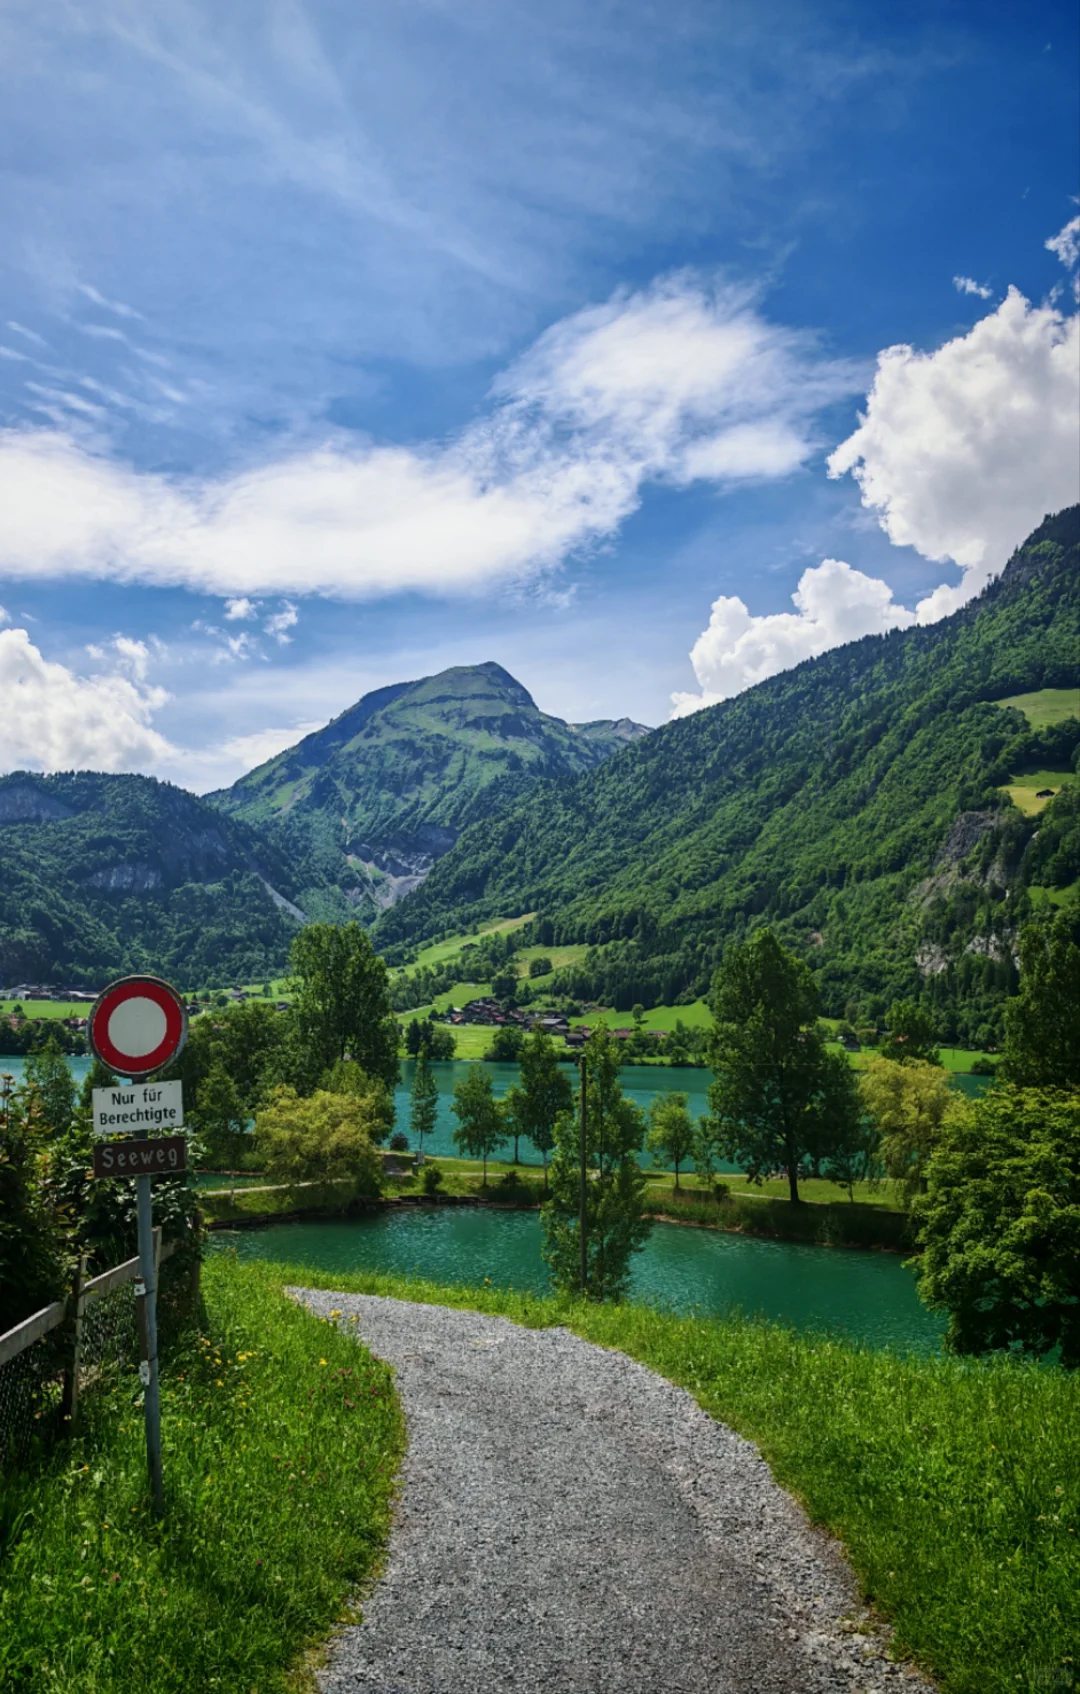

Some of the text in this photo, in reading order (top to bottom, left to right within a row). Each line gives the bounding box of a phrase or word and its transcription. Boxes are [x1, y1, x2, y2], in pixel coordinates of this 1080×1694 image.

[112, 1088, 162, 1105] Nur für
[99, 1107, 176, 1125] Berechtigte
[102, 1147, 177, 1168] Seeweg
